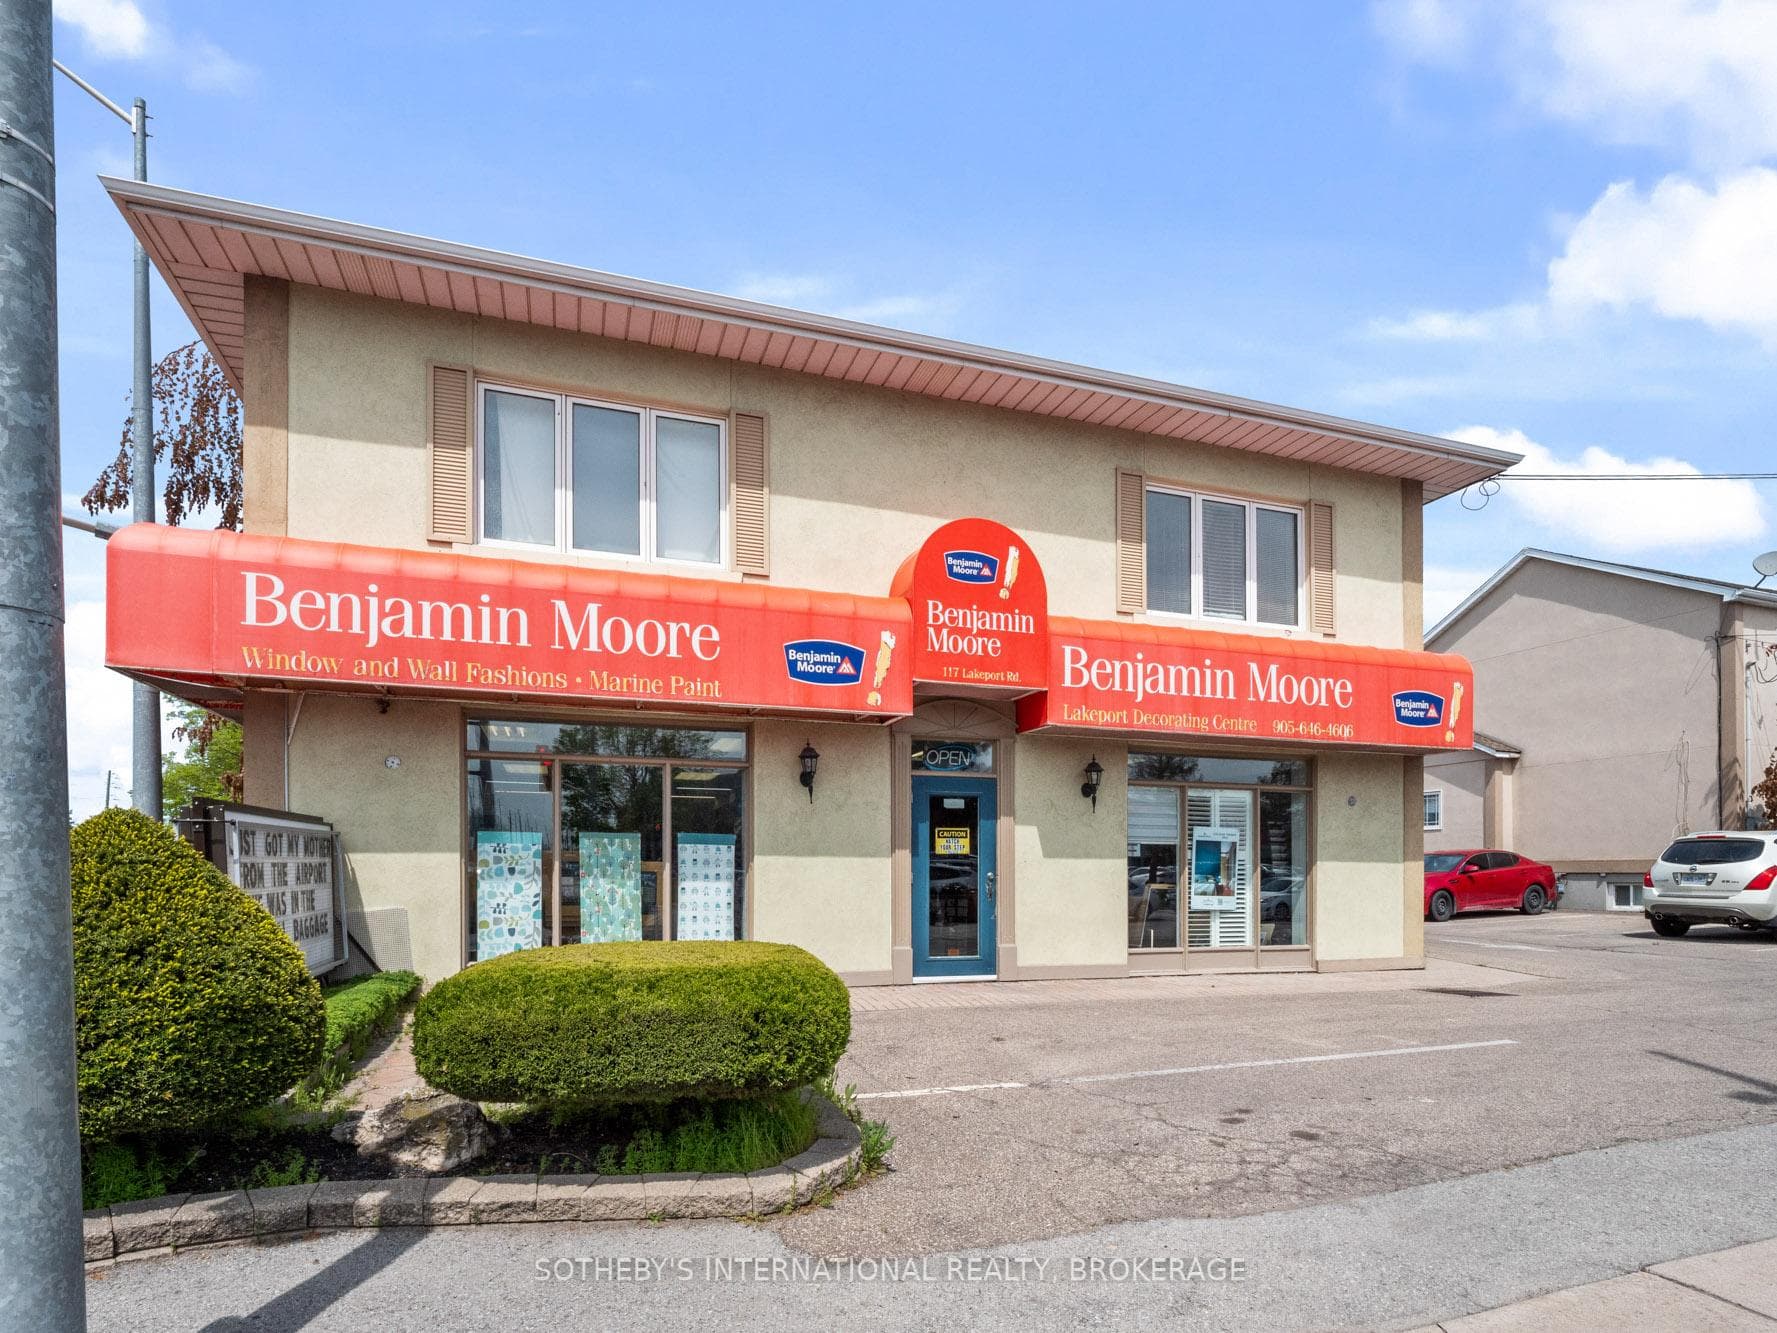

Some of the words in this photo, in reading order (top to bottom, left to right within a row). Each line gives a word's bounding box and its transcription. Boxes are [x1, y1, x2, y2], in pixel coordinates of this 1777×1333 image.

[947, 556, 983, 568] Benjamin
[953, 566, 978, 575] Moore
[240, 571, 532, 648] Benjamin
[550, 599, 721, 661] Moore
[926, 599, 1035, 634] Benjamin
[926, 627, 1001, 657] Moore
[788, 649, 841, 664] Benjamin
[241, 646, 343, 674] Window
[353, 656, 399, 679] and
[406, 657, 457, 682] Wall
[465, 662, 568, 689] Fashions
[589, 670, 663, 695] Marine
[670, 675, 722, 698] Paint
[797, 661, 834, 674] Moore
[943, 666, 959, 678] 117
[962, 668, 1004, 682] Lakeport
[1006, 671, 1022, 682] Rd.
[1061, 645, 1237, 703] Benjamin
[1247, 662, 1353, 709] Moore
[1395, 699, 1430, 711] Benjamin
[1400, 708, 1425, 718] Moore
[1063, 704, 1128, 724] Lakeport
[1133, 708, 1209, 731] Decorating
[1213, 714, 1257, 733] Centre
[1272, 719, 1354, 739] 905-646-4606
[926, 749, 970, 766] OPEN
[939, 830, 966, 838] CAUTION
[265, 832, 284, 857] GOT
[240, 862, 265, 889] ROM
[271, 862, 288, 887] THE
[295, 862, 327, 885] AIRPORT
[293, 913, 329, 942] BAGGAGE
